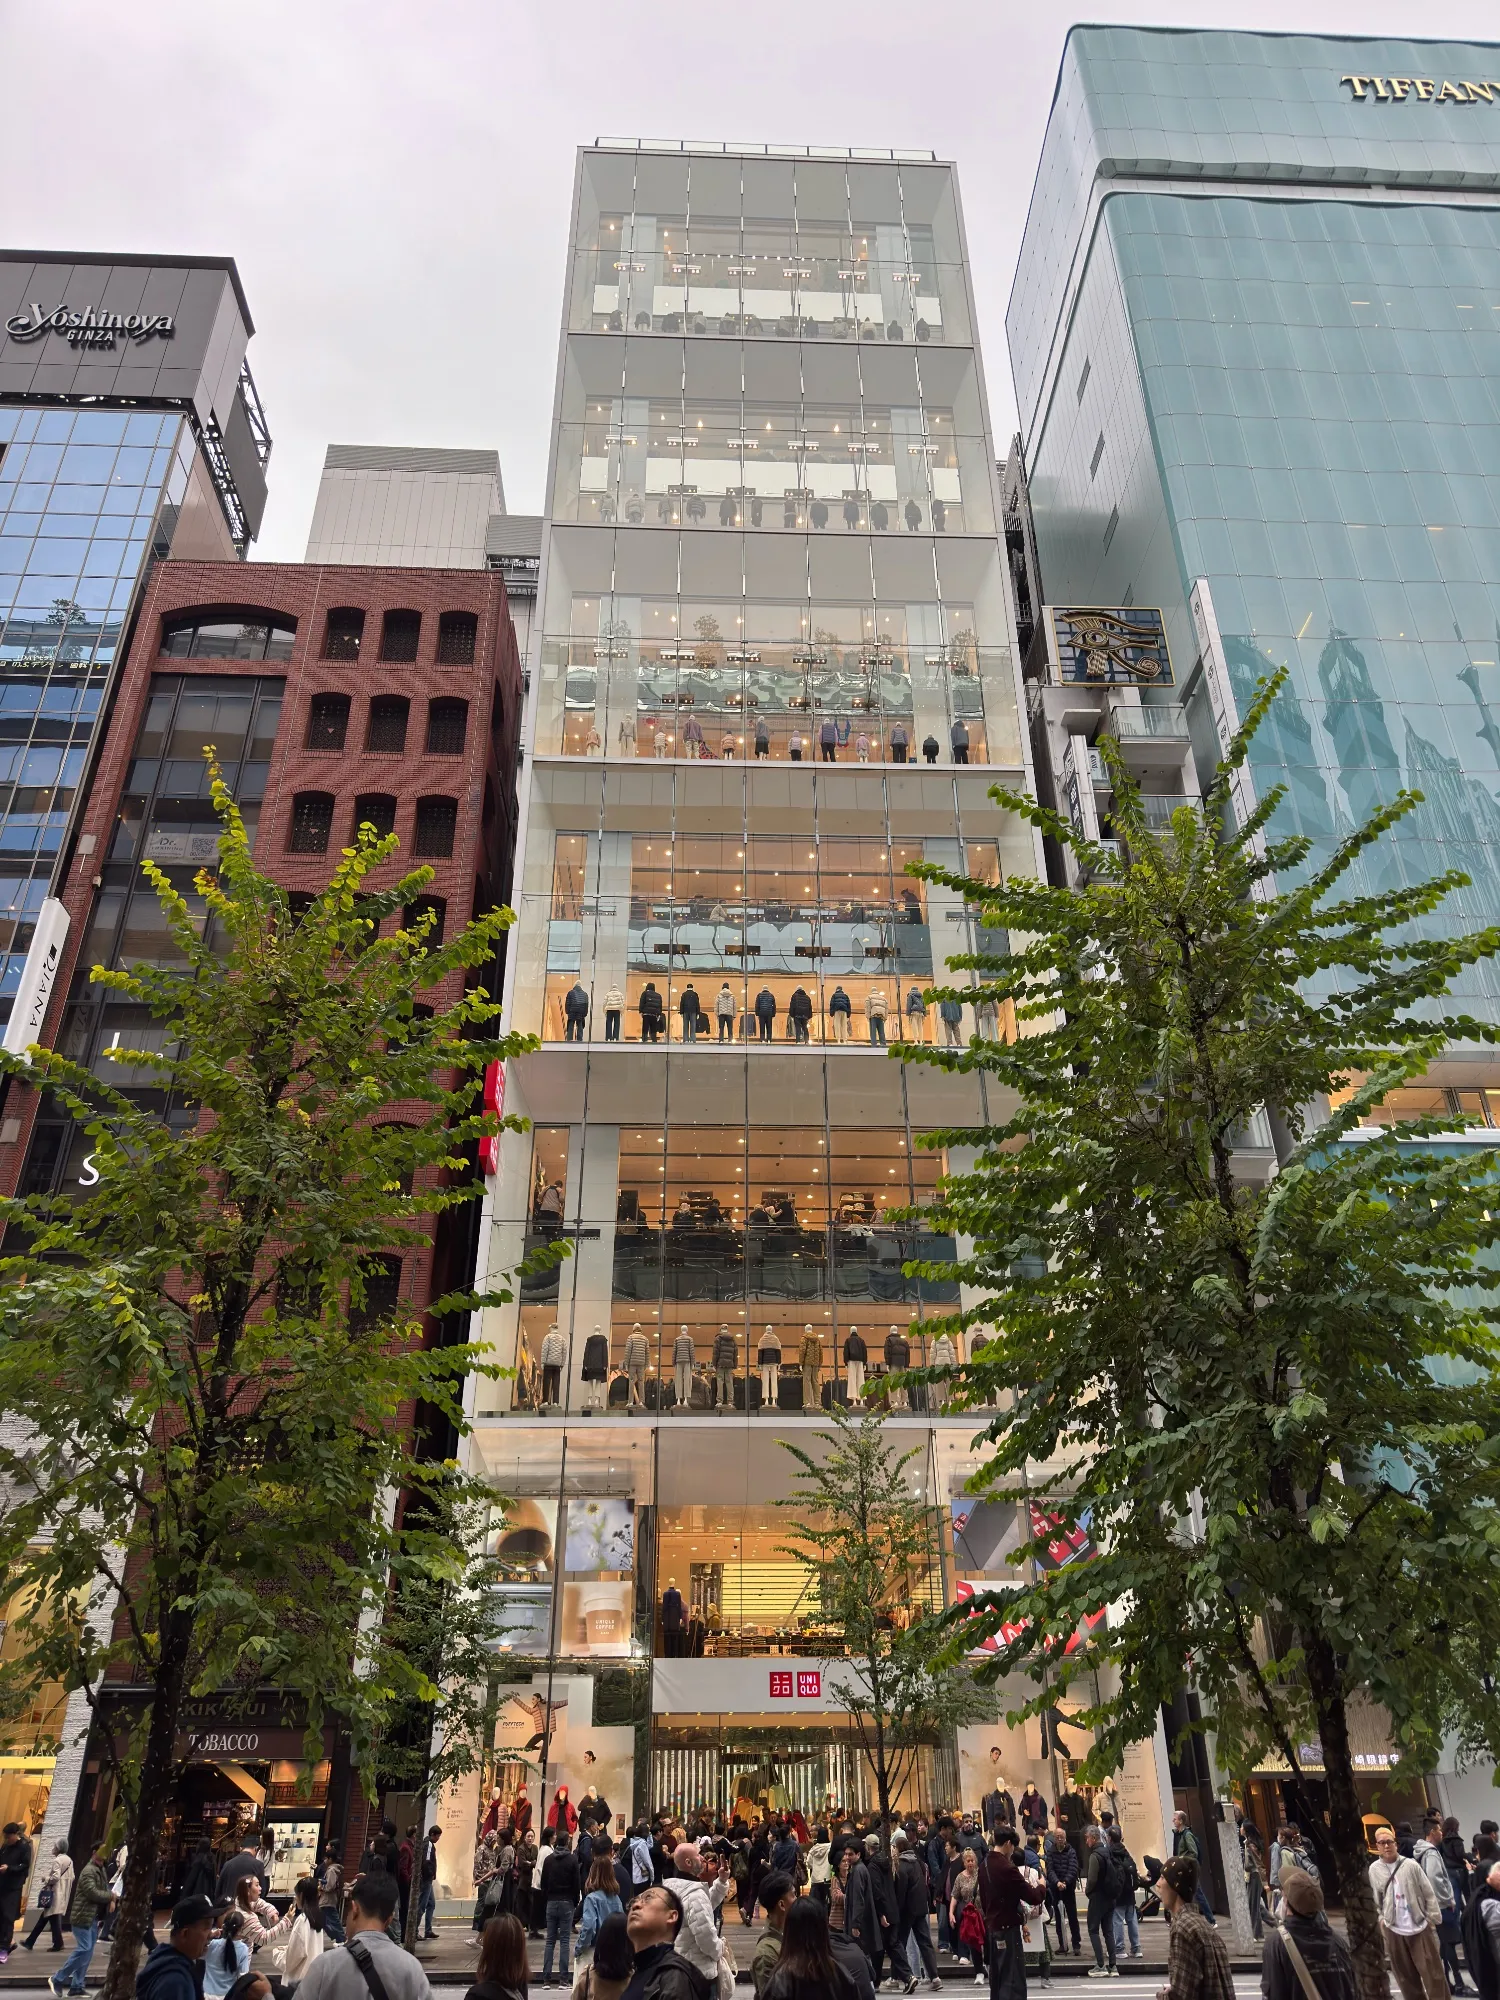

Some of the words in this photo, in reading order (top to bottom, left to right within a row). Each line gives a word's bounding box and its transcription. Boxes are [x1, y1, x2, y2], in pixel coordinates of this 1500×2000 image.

[5, 303, 173, 337] Yoshinoya
[66, 330, 114, 341] GINZA
[188, 1733, 259, 1751] TOBACCO
